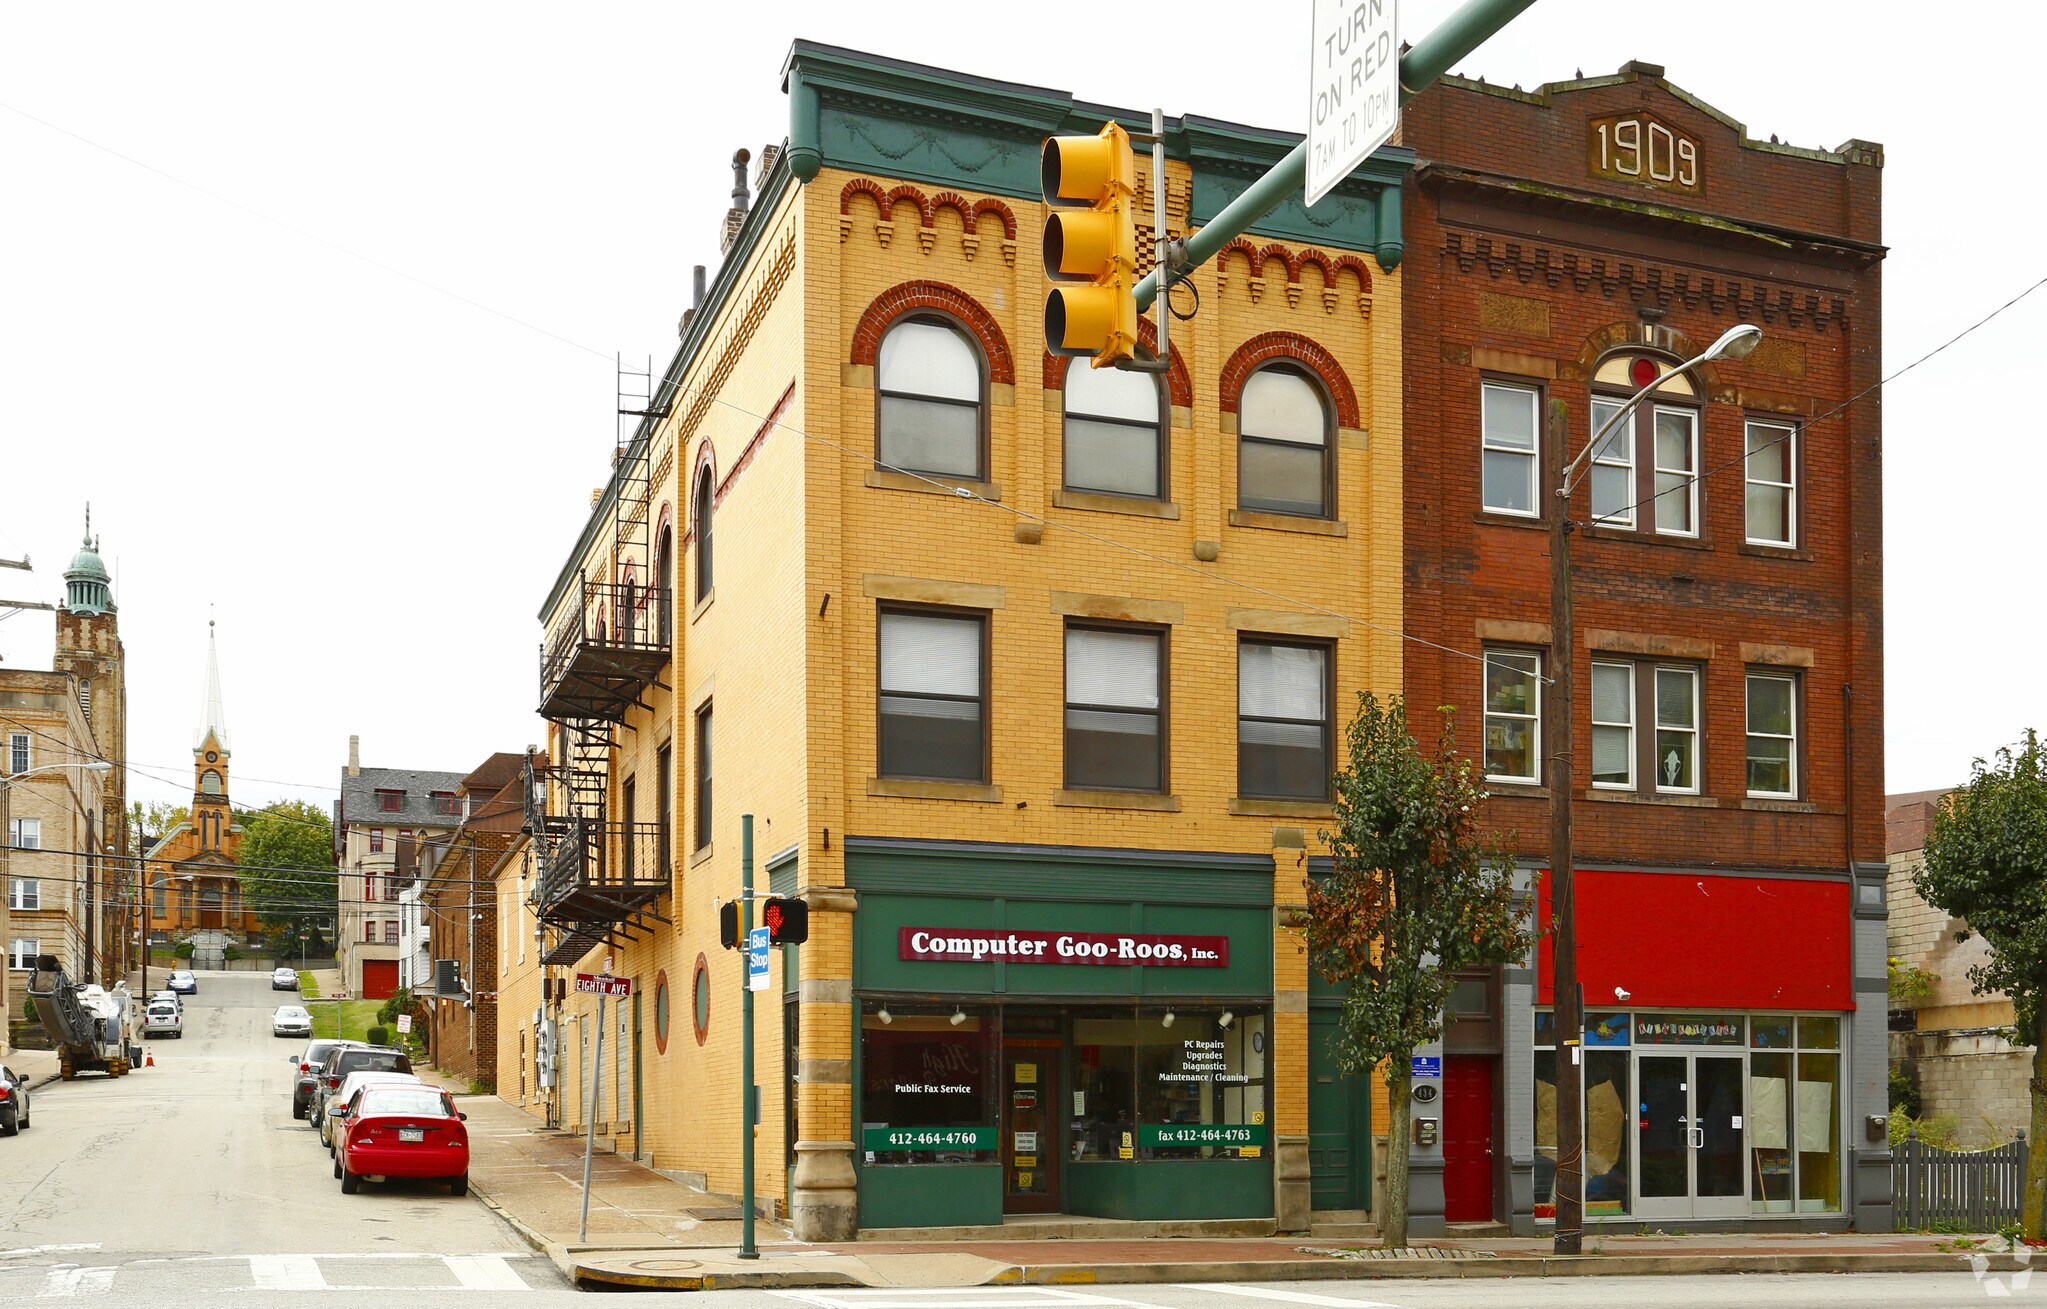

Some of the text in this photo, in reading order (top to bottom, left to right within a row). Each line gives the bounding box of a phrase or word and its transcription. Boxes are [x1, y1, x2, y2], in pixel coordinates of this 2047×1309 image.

[1325, 0, 1382, 69] TURN
[1316, 30, 1390, 126] ON RED
[1315, 84, 1389, 177] 7AM TO 10PM
[1598, 119, 1696, 186] 1909
[752, 934, 767, 949] Bus
[911, 931, 1219, 962] Computer Goo-Roos, Inc.
[750, 952, 768, 969] Stop
[576, 979, 627, 996] EIGHTH AVE
[1184, 1040, 1225, 1050] PC Repairs
[1186, 1051, 1223, 1061] Upgrades
[1182, 1062, 1227, 1072] Diagnostics
[1159, 1073, 1208, 1082] Maintenance
[1215, 1073, 1249, 1083] Cleaning
[895, 1084, 971, 1093] Public Fax Service
[1418, 1088, 1433, 1098] 434
[889, 1132, 977, 1145] 412-464-4760
[1158, 1129, 1251, 1141] fax 412-464-4763
